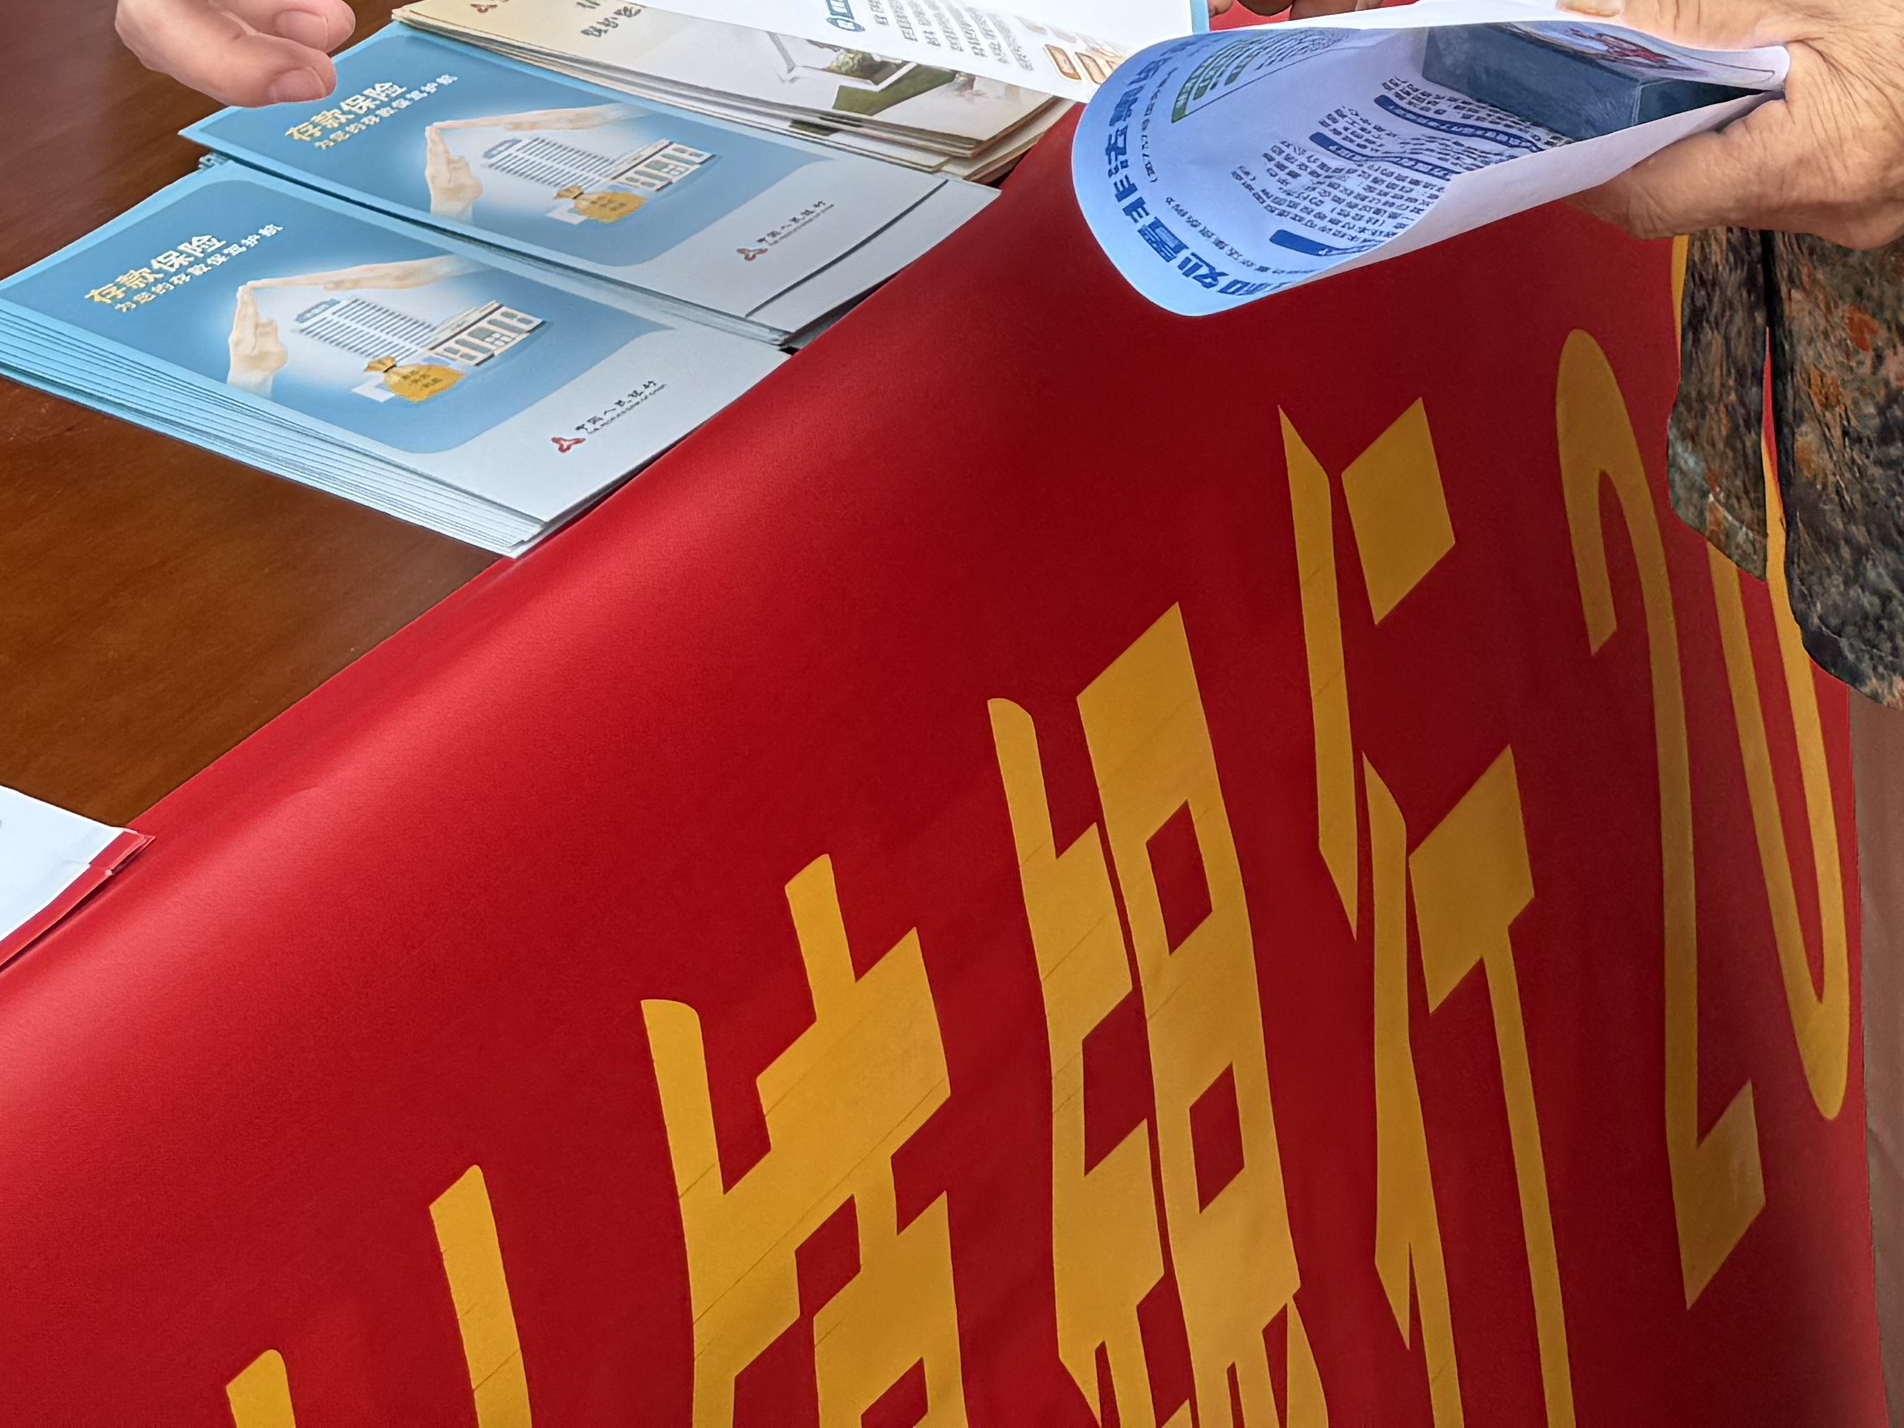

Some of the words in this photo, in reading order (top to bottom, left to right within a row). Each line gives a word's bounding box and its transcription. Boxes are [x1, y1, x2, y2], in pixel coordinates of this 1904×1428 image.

[285, 80, 408, 143] 存款保险
[84, 233, 227, 306] 存款保险
